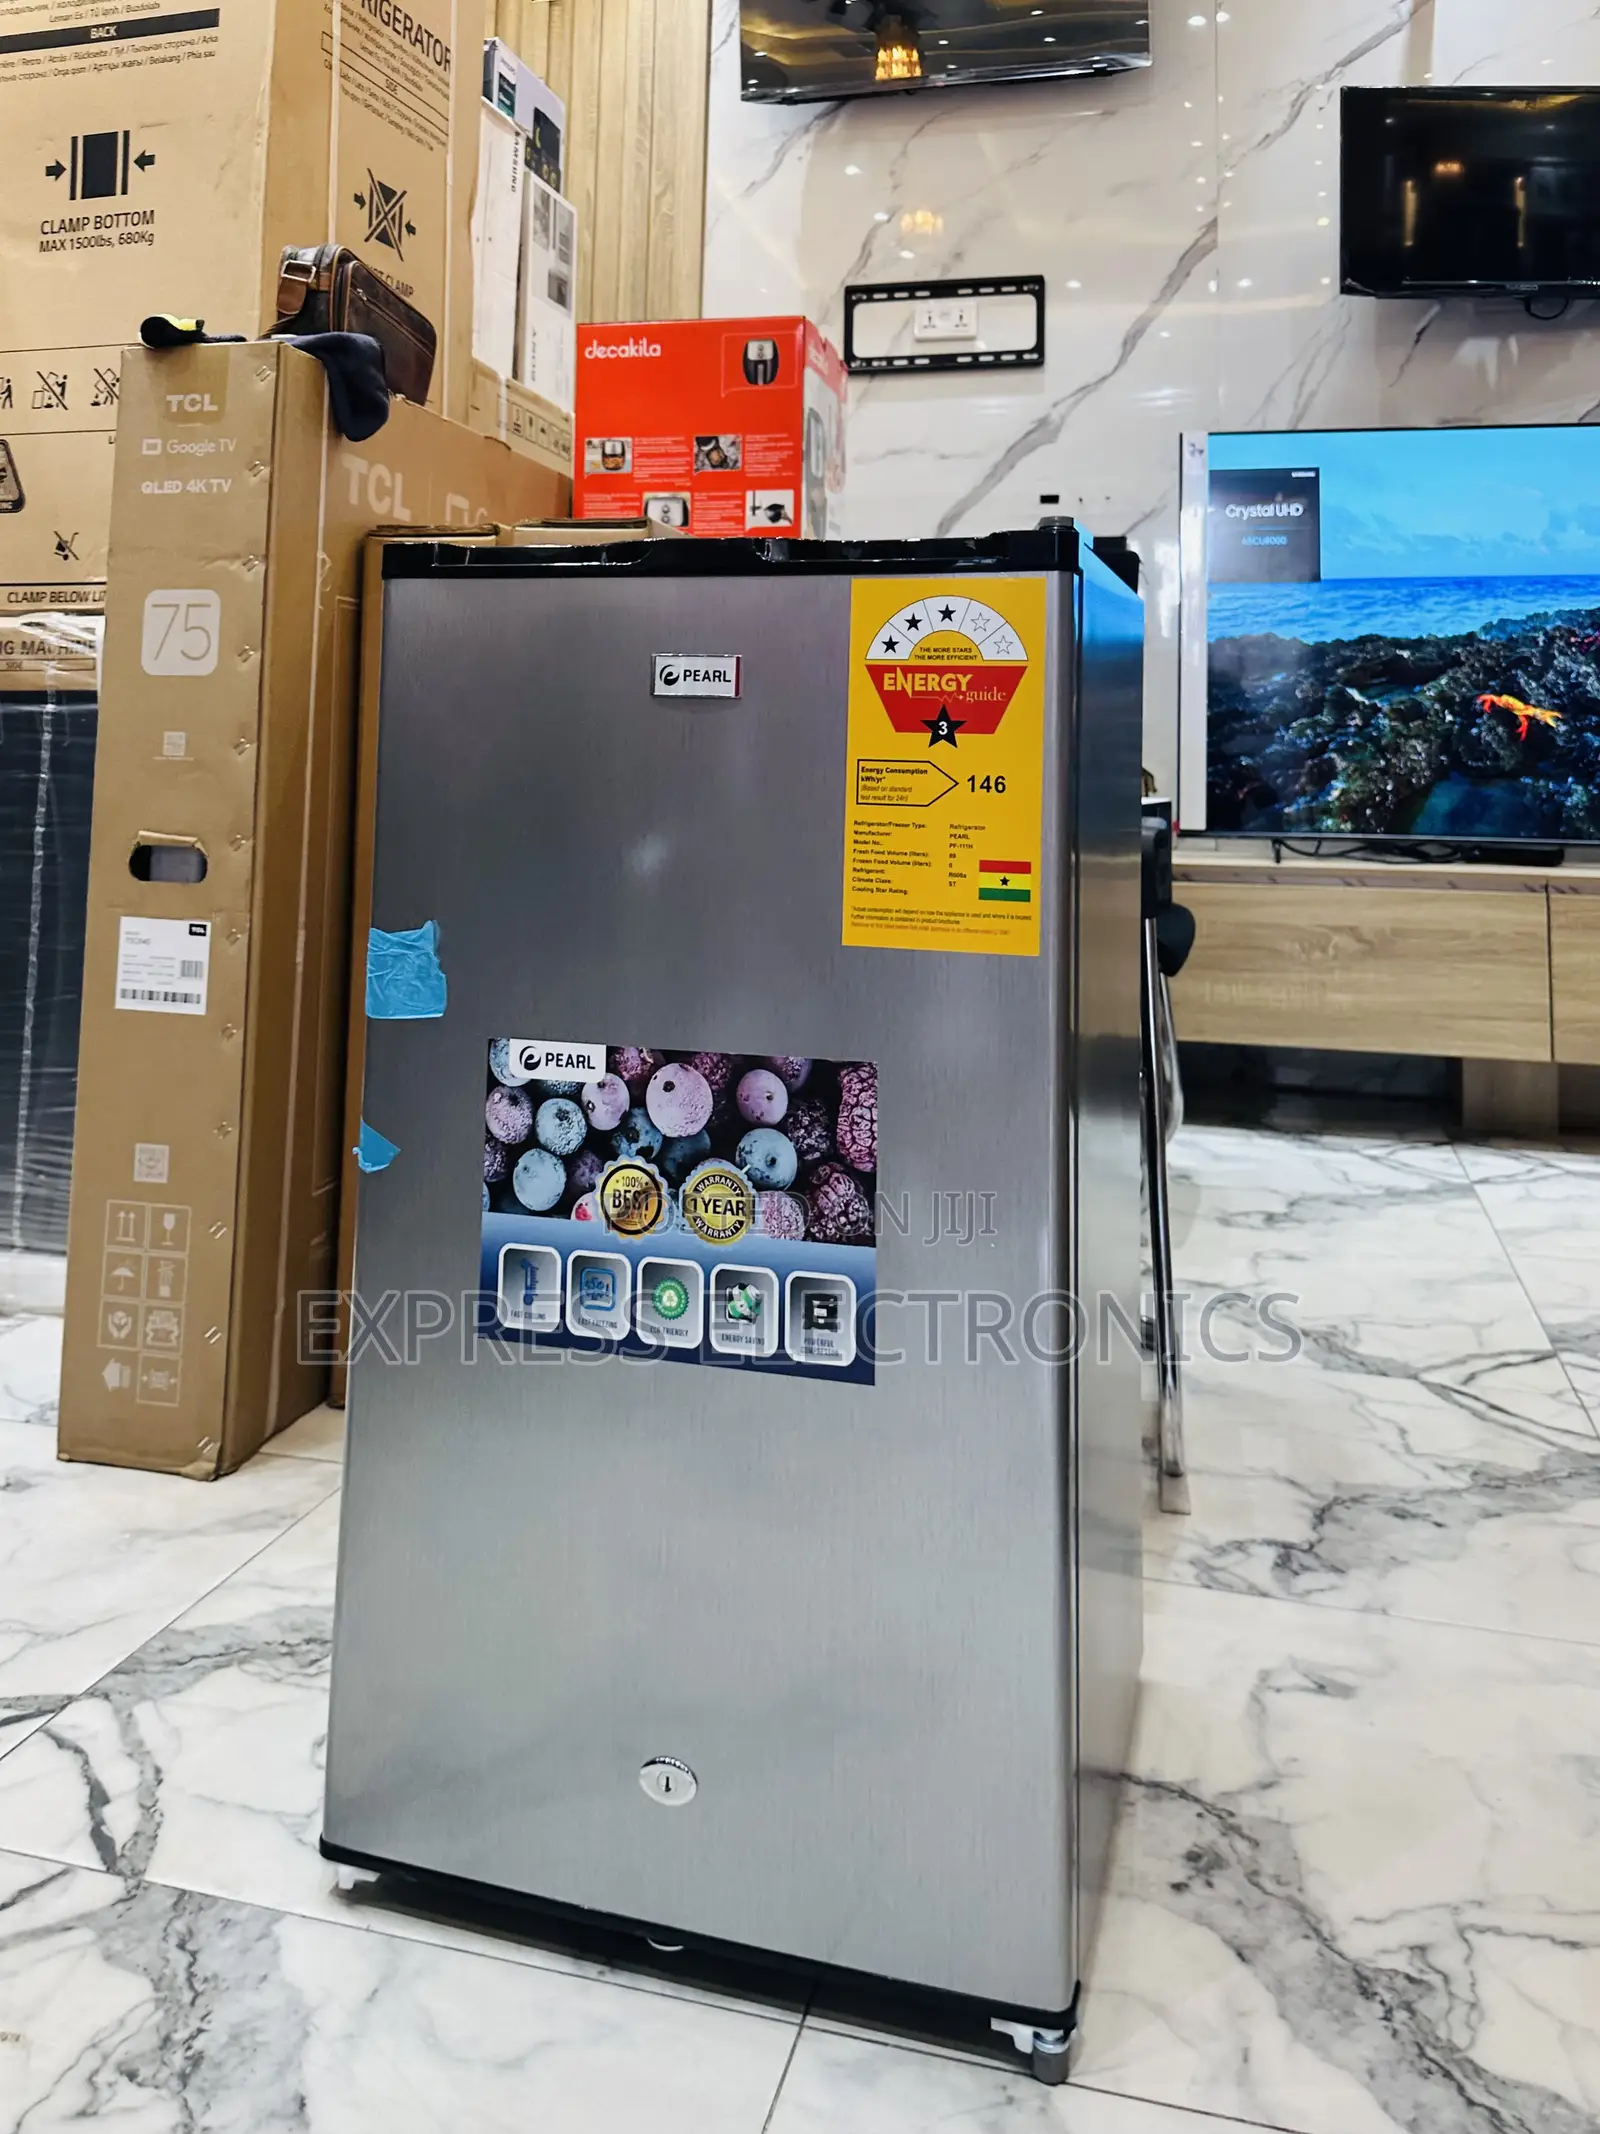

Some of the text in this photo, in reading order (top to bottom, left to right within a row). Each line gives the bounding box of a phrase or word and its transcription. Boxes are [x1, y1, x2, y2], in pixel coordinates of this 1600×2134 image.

[90, 26, 117, 39] BACK
[40, 209, 155, 236] CLAMP BOTTOM
[39, 230, 155, 254] MAX 1500lbs, 680Kg
[584, 337, 662, 360] decakila
[166, 393, 218, 413] TCL
[167, 438, 237, 457] Google TV
[141, 478, 232, 494] QLED 4K TV
[341, 453, 412, 522] TCL
[1225, 503, 1304, 520] Crystal UHD
[7, 591, 47, 603] CLAMP
[49, 591, 90, 603] BELOW
[151, 603, 212, 662] 75
[683, 669, 732, 683] PEARL
[883, 667, 973, 698] ENERGY
[966, 686, 1007, 704] guide
[938, 721, 949, 736] 3
[861, 766, 928, 776] Energy Consumption
[967, 775, 1007, 794] 146
[544, 1052, 596, 1070] PEARL
[621, 1175, 644, 1188] 100%
[696, 1174, 742, 1197] WARRANTY
[612, 1189, 651, 1211] BEST
[690, 1197, 747, 1217] 1 YEAR
[694, 1217, 742, 1240] WARRANTY
[662, 1327, 689, 1337] FRIENDLY
[721, 1333, 743, 1343] ENERGY
